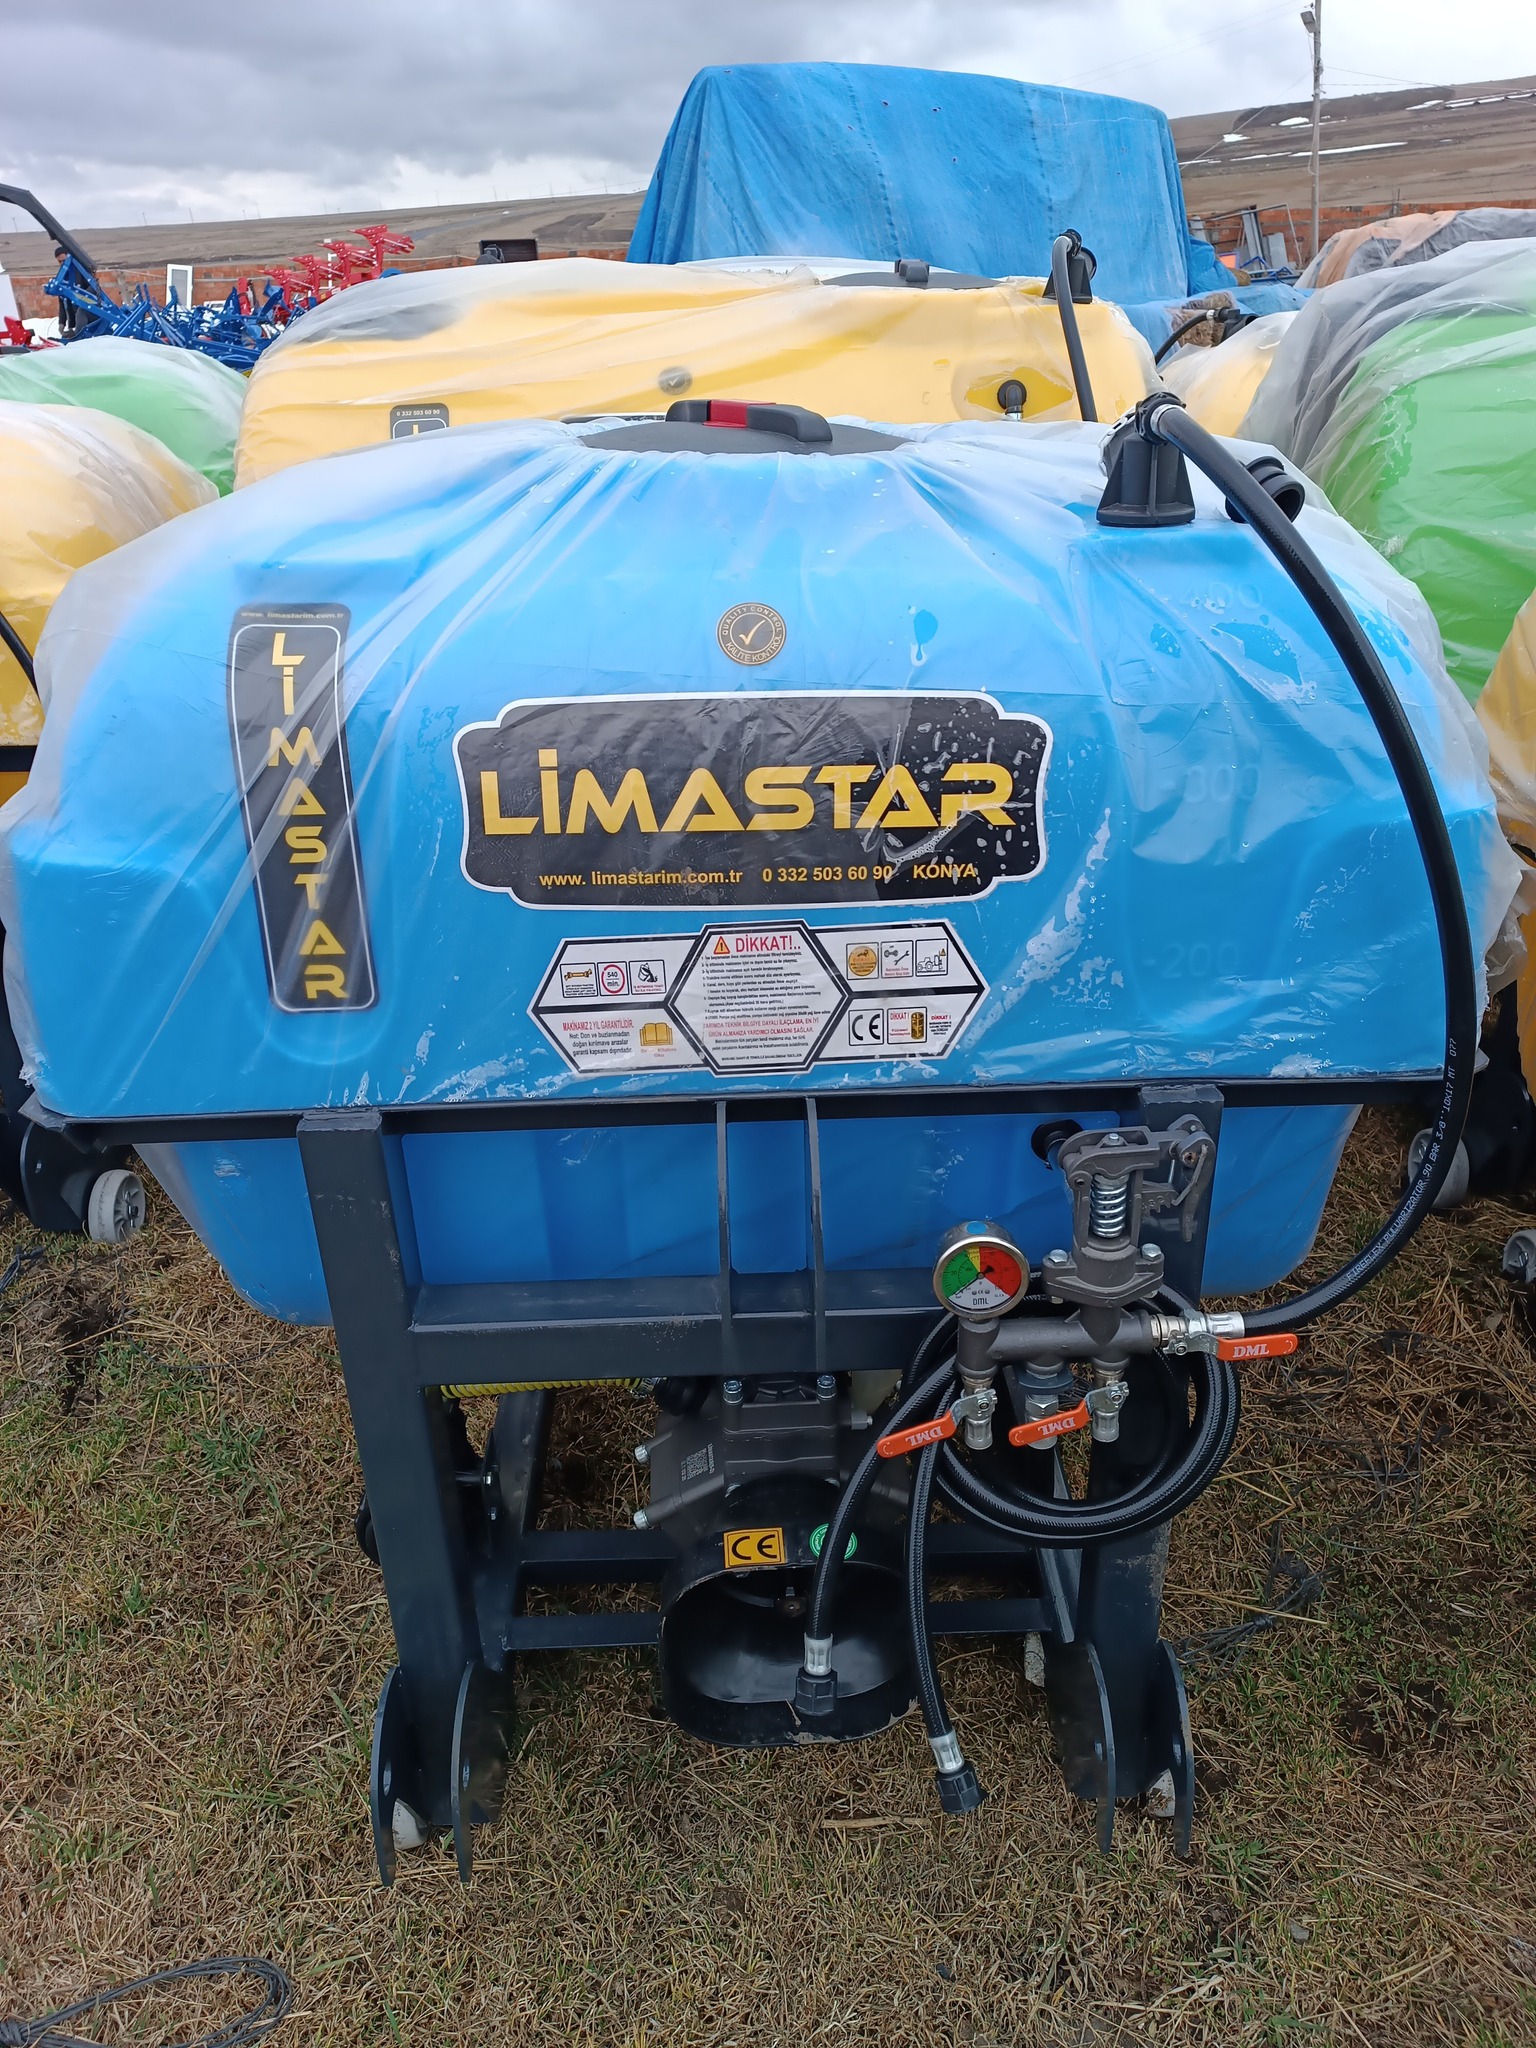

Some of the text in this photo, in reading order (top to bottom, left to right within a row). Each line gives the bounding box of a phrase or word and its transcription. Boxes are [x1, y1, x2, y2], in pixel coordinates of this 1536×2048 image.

[266, 611, 345, 620] limastarim.com.tr
[722, 607, 747, 636] QUALITY
[750, 605, 782, 633] CONTROL
[752, 634, 782, 662] KONTROL
[480, 748, 1017, 835] LİMASTAR
[267, 633, 349, 999] LİMASTAR
[538, 863, 978, 887] www. limastarim.com.tr 0 332 503 60 90 KONYA
[607, 971, 618, 979] 540
[1428, 1141, 1441, 1163] BAR
[1232, 1343, 1272, 1360] DML
[904, 1425, 945, 1447] DML
[1036, 1415, 1077, 1436] DML
[731, 1533, 778, 1561] CE
